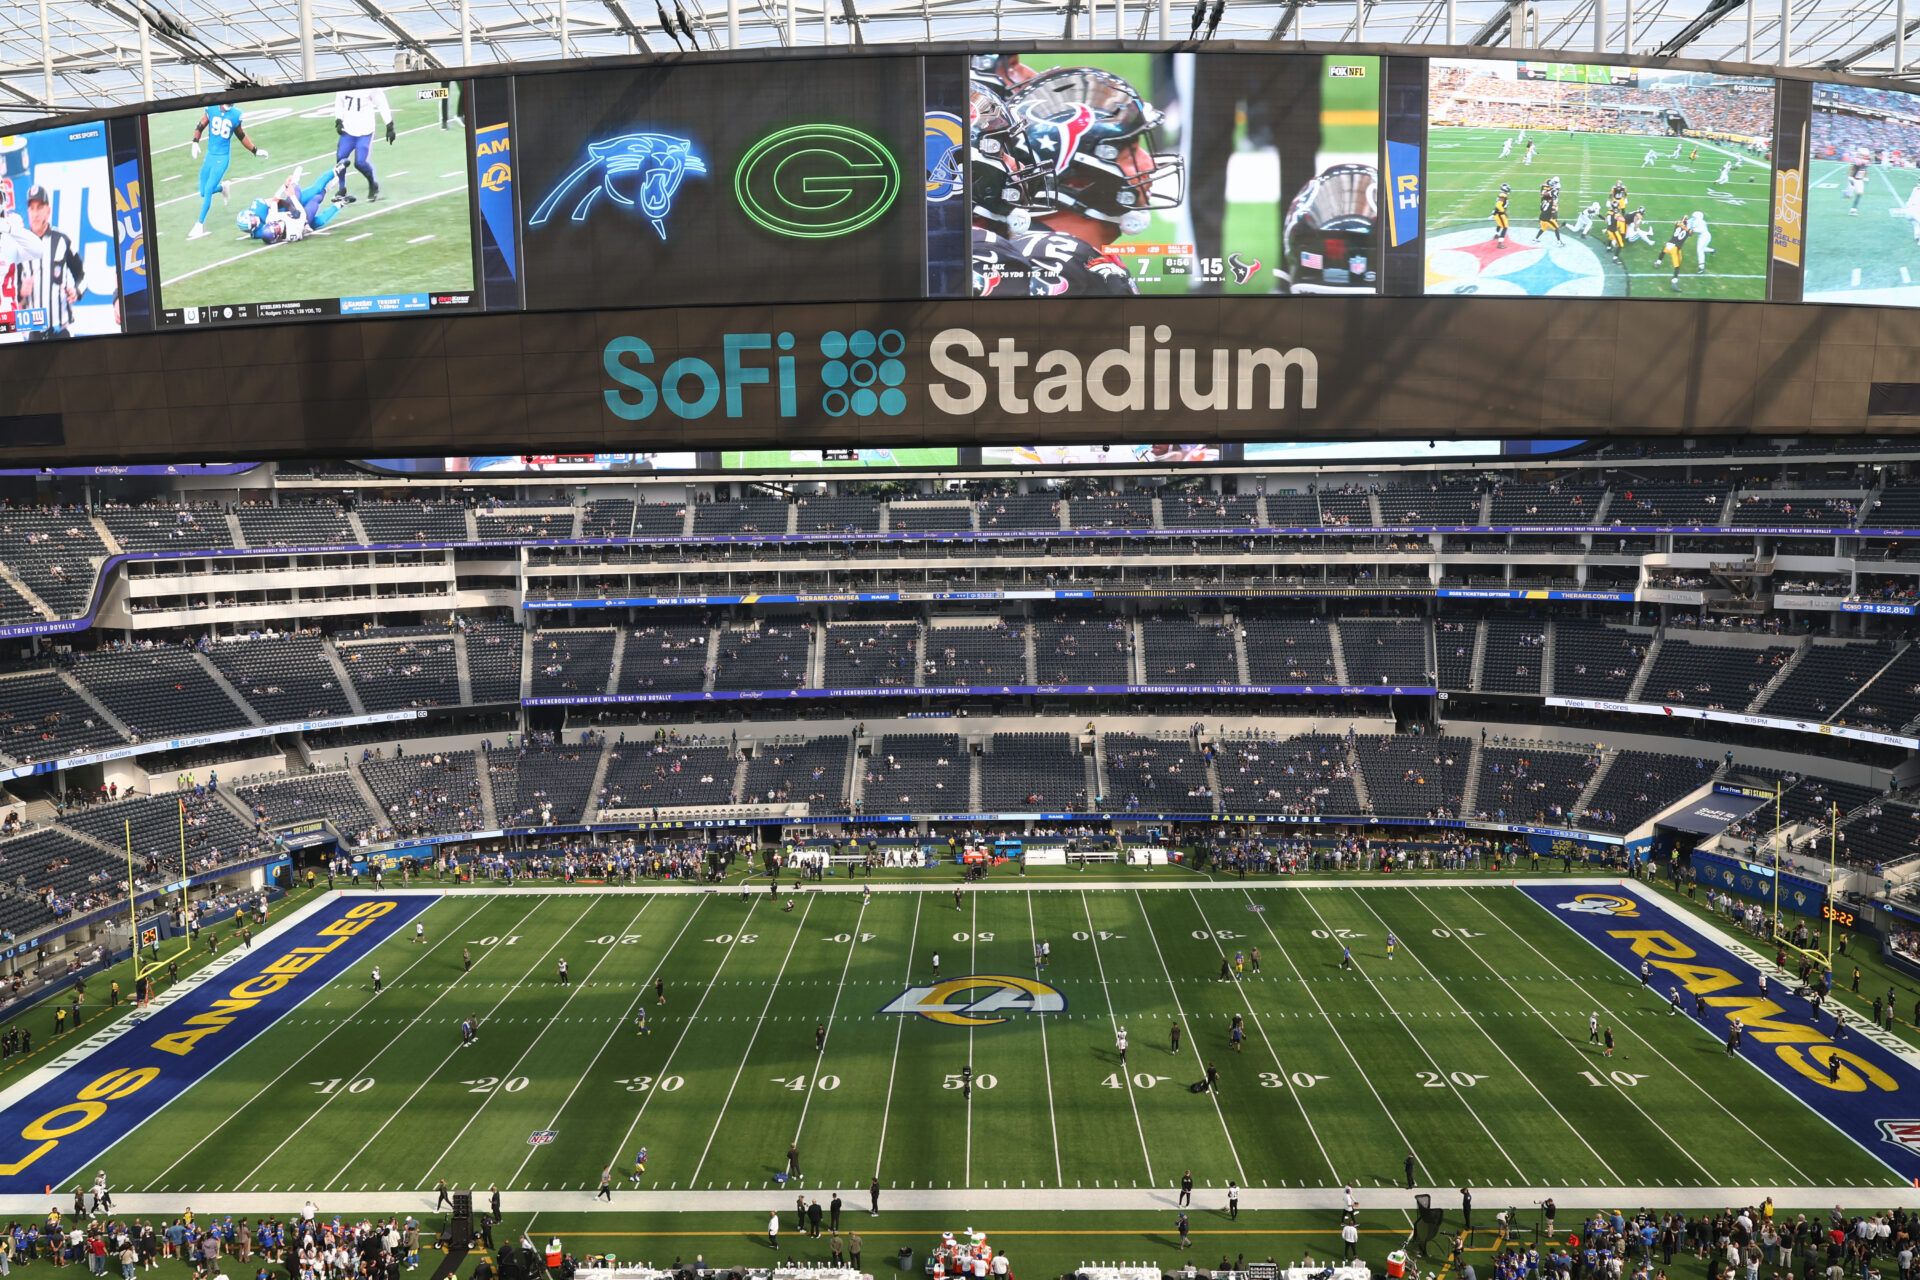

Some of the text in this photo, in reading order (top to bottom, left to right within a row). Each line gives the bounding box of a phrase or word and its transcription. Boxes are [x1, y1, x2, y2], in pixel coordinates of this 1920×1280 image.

[1349, 66, 1364, 76] NFL
[434, 89, 447, 98] NFL
[345, 95, 361, 111] 71
[212, 116, 232, 139] 96
[1137, 258, 1150, 275] 7
[1200, 257, 1224, 275] 15
[17, 311, 30, 326] 10
[602, 331, 798, 421] SoFi
[927, 324, 1319, 416] Stadium
[1565, 699, 1629, 711] Week Scores
[1820, 725, 1831, 733] 28
[1884, 736, 1903, 745] FINAL
[68, 749, 132, 767] Week Leaders
[639, 819, 747, 829] RAMS HOUSE
[1823, 905, 1854, 926] 58:22
[143, 928, 157, 945] 25
[481, 928, 1477, 946] 10 20 30 40 50 40 30 20 10
[47, 1056, 78, 1070] IT
[151, 985, 192, 1007] ALL
[188, 970, 215, 988] OF
[212, 953, 243, 968] US
[1606, 930, 1900, 1092] RAMS
[0, 900, 398, 1177] LOS ANGELES
[321, 1070, 1639, 1095] 10 20 30 40 50 40 30 20 10
